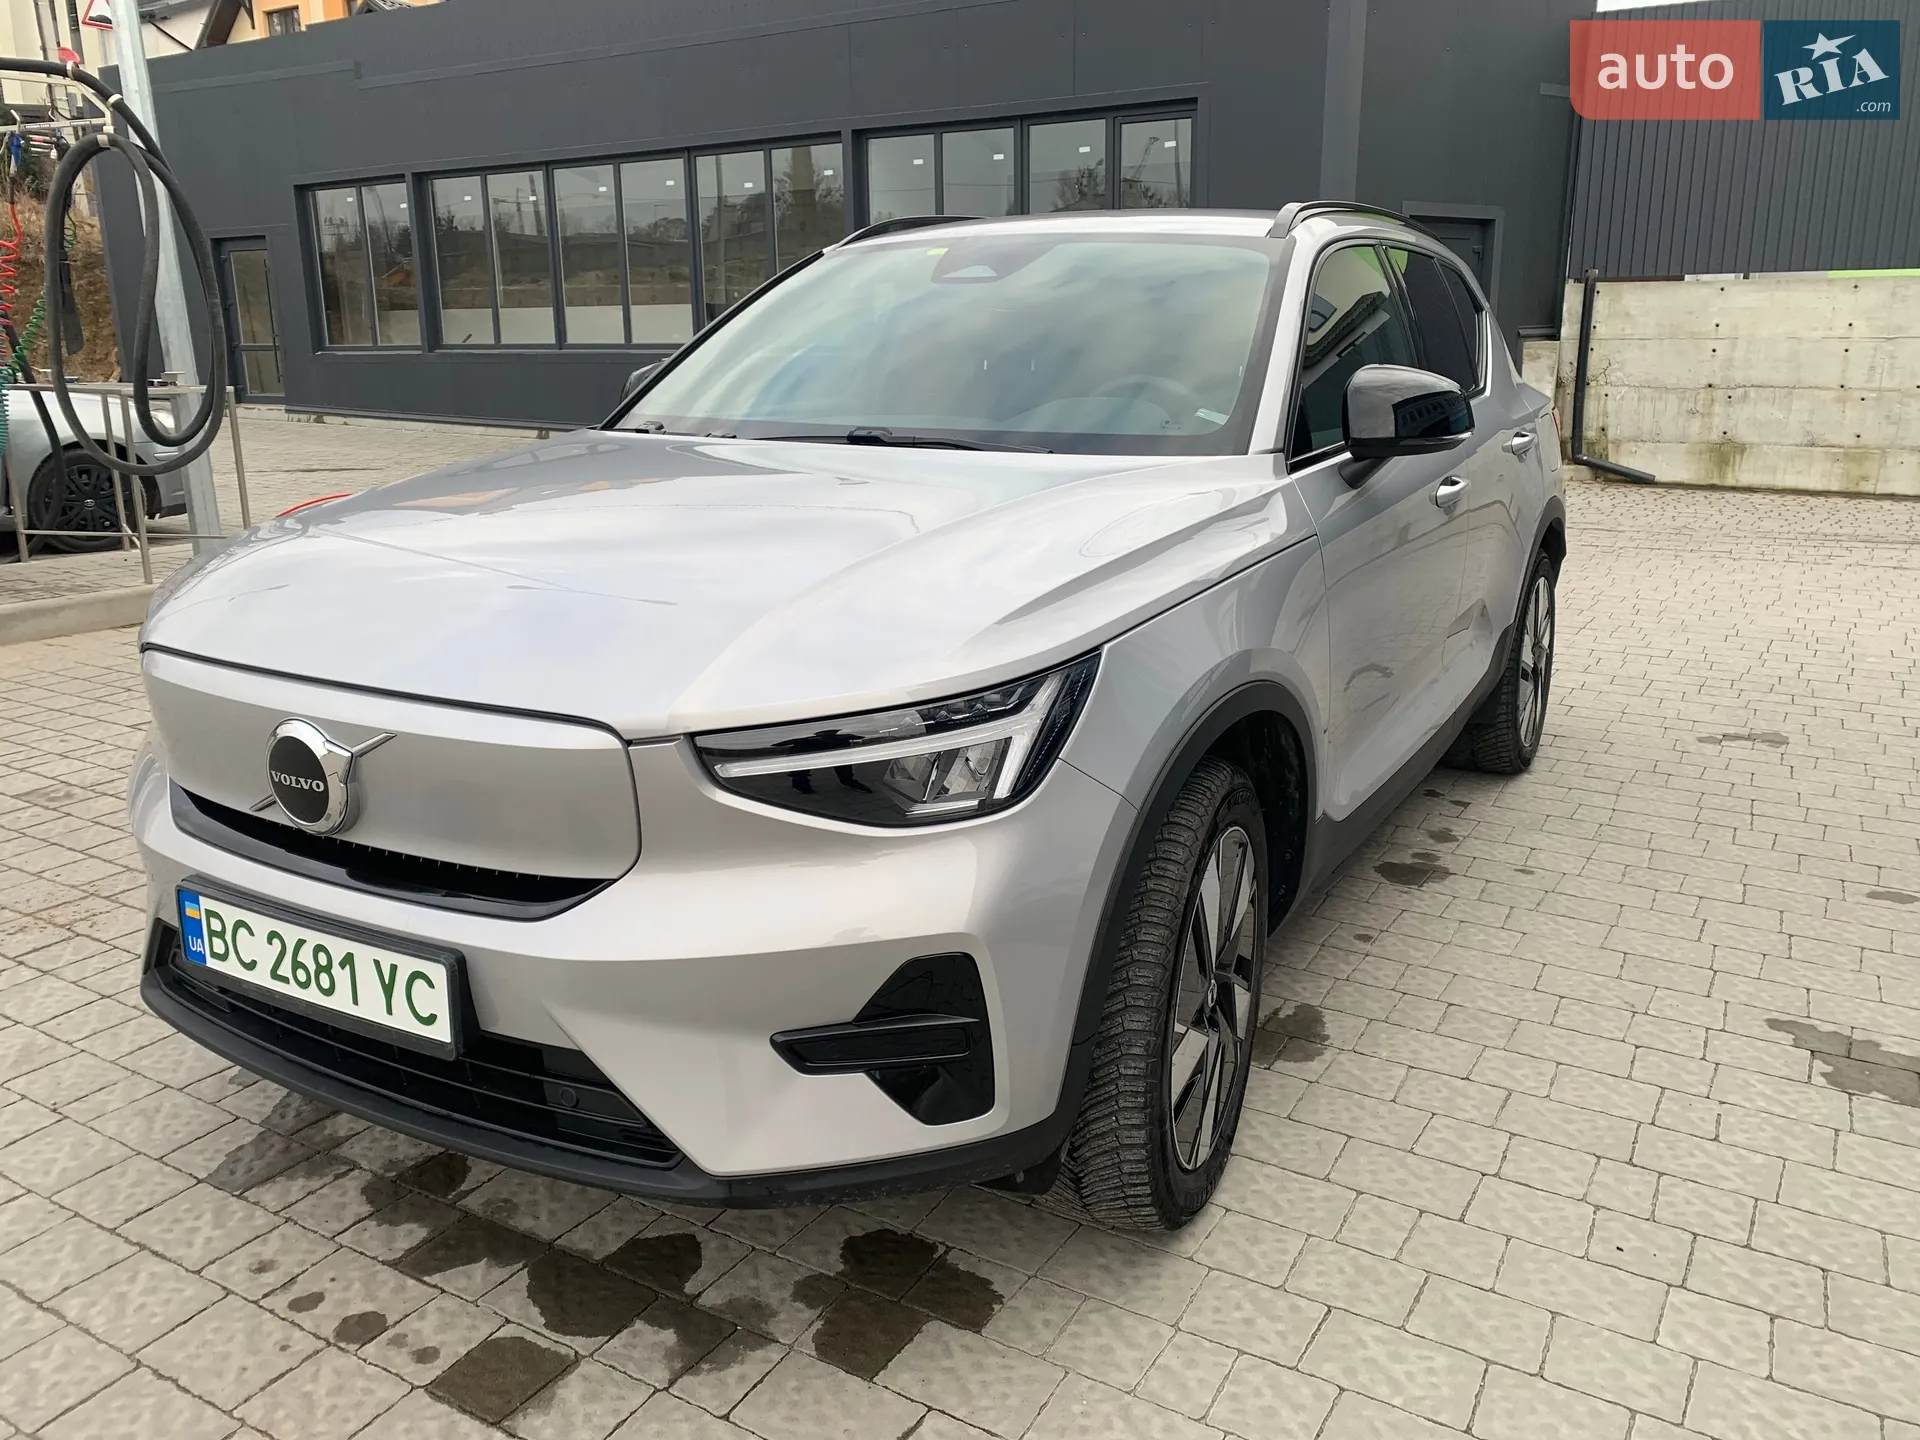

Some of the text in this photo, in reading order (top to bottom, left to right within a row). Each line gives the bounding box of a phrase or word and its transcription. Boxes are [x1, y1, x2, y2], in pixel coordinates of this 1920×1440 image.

[270, 770, 325, 792] VOLVO
[188, 935, 205, 955] UA
[204, 908, 438, 1026] BC 2681 YC
